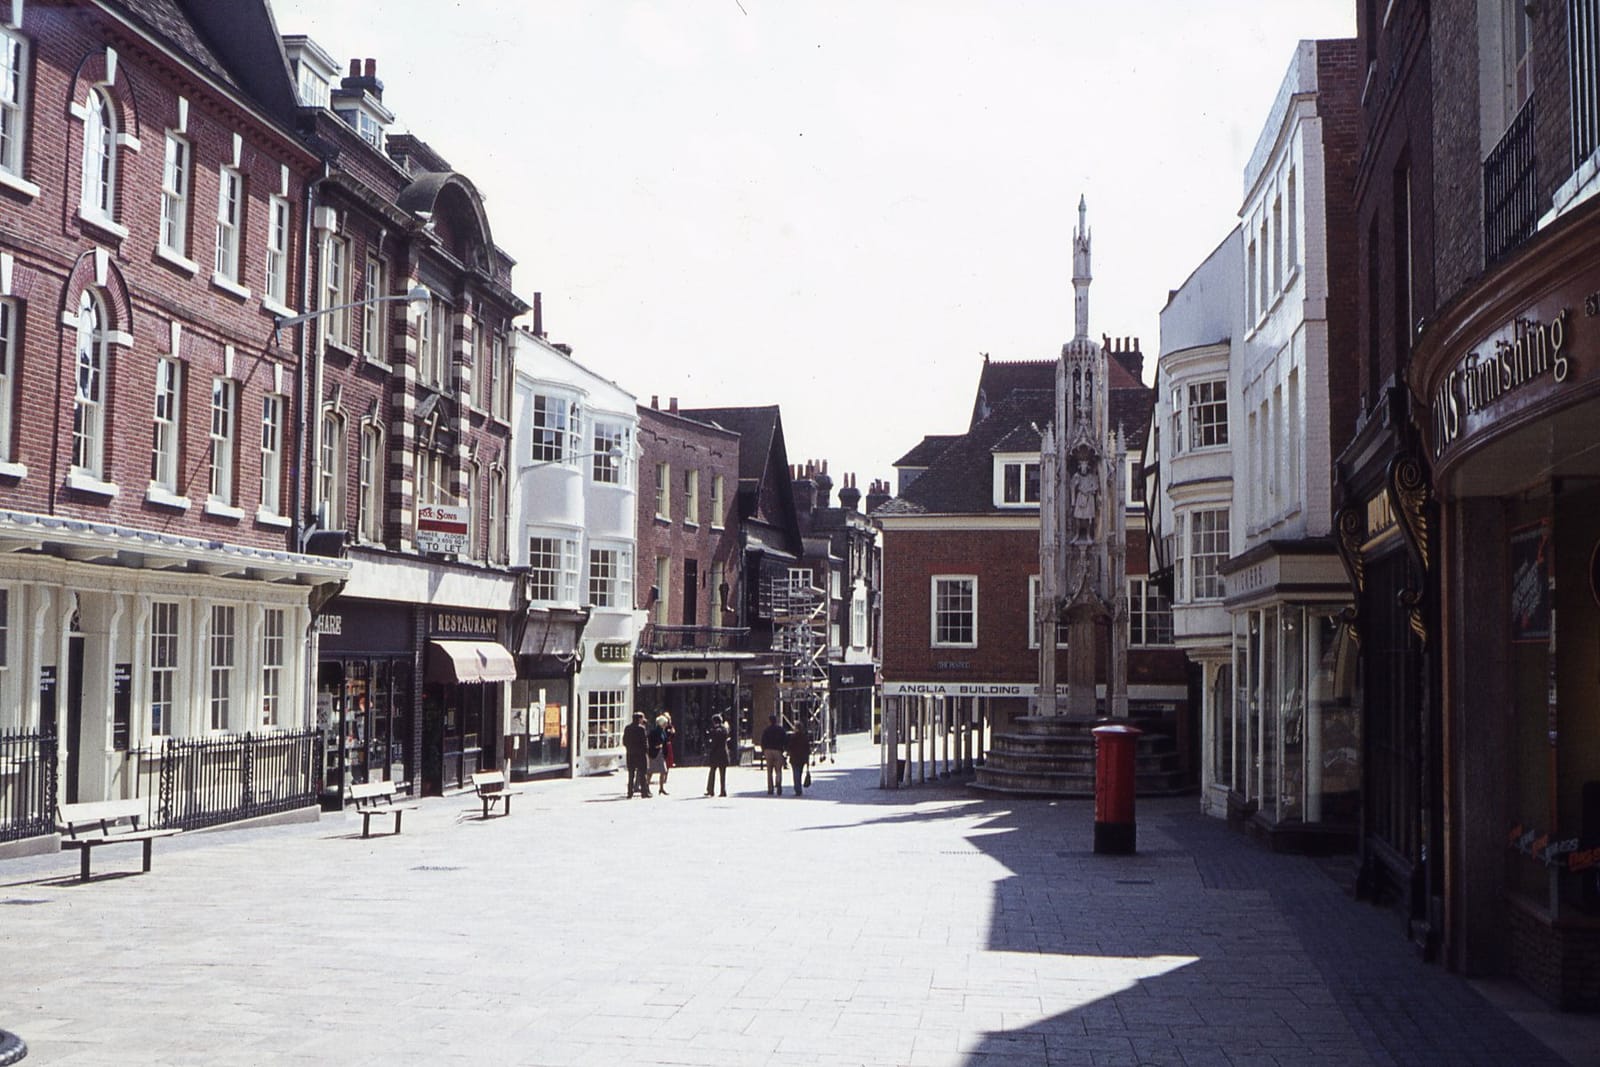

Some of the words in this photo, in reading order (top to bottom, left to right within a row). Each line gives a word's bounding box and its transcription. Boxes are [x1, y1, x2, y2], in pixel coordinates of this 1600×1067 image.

[1464, 309, 1568, 413] furnishing
[426, 543, 439, 551] TO
[444, 544, 463, 553] LET
[438, 614, 497, 634] RESTAURANT
[899, 685, 946, 694] ANGLIA
[959, 685, 1020, 695] BUILDING
